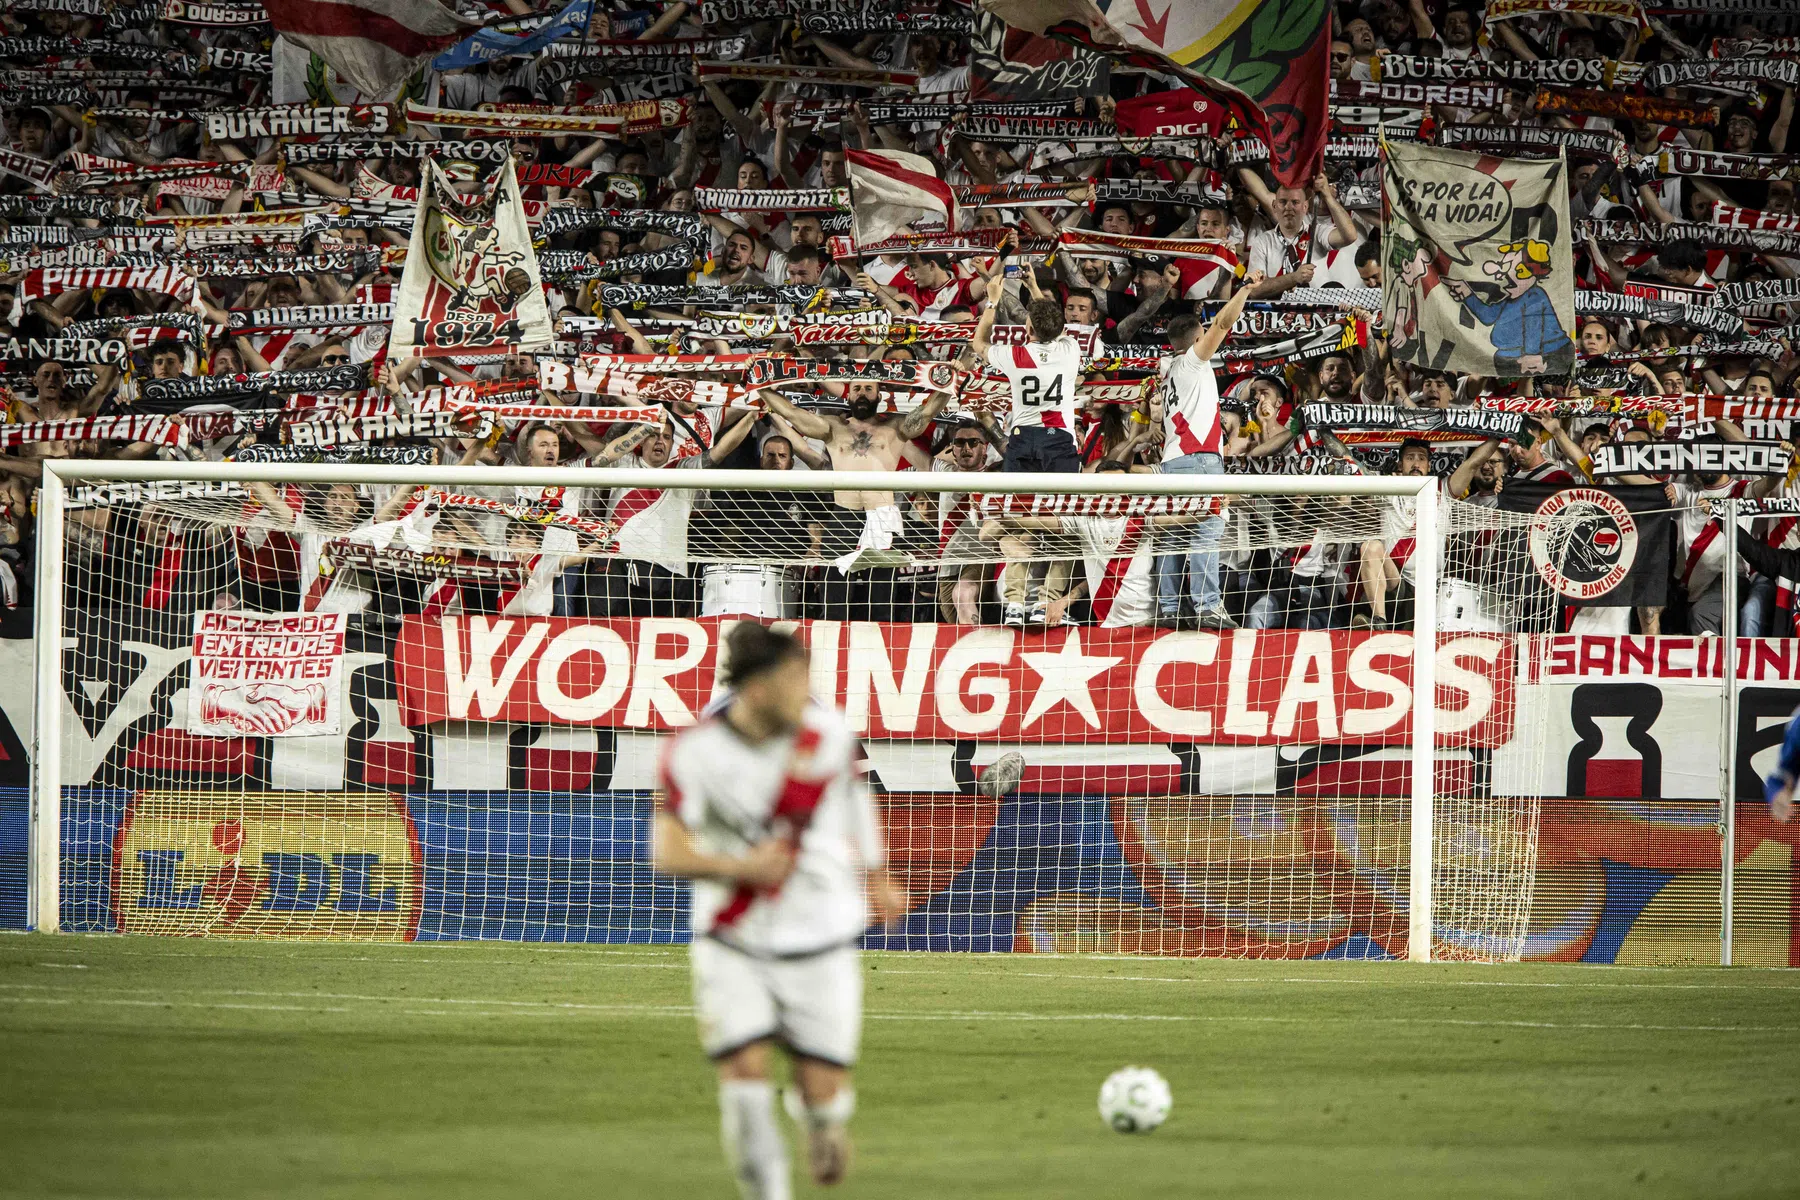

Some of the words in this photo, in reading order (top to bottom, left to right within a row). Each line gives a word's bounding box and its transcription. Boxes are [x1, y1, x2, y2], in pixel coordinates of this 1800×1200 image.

[1037, 55, 1099, 91] 1924
[1383, 53, 1607, 84] BUKANEROS
[897, 105, 950, 118] JAHRE
[971, 101, 1068, 118] STURMFLUT
[1155, 122, 1209, 137] DIGI
[1421, 181, 1464, 201] POR
[1468, 181, 1496, 201] LA
[1446, 201, 1504, 224] VIDA!
[446, 311, 497, 322] DESDE
[410, 317, 526, 348] 1924
[1021, 373, 1064, 407] 24
[1301, 403, 1396, 425] PALESTINA
[1684, 393, 1715, 427] EL
[1592, 442, 1790, 475] BUKANEROS
[1581, 564, 1627, 597] BANLIEUE
[200, 612, 339, 634] ACUERDO
[199, 634, 340, 656] ENTRADAS
[1546, 634, 1800, 681] SANCION
[198, 658, 335, 680] VISITANTES
[1133, 628, 1504, 738] CLASS
